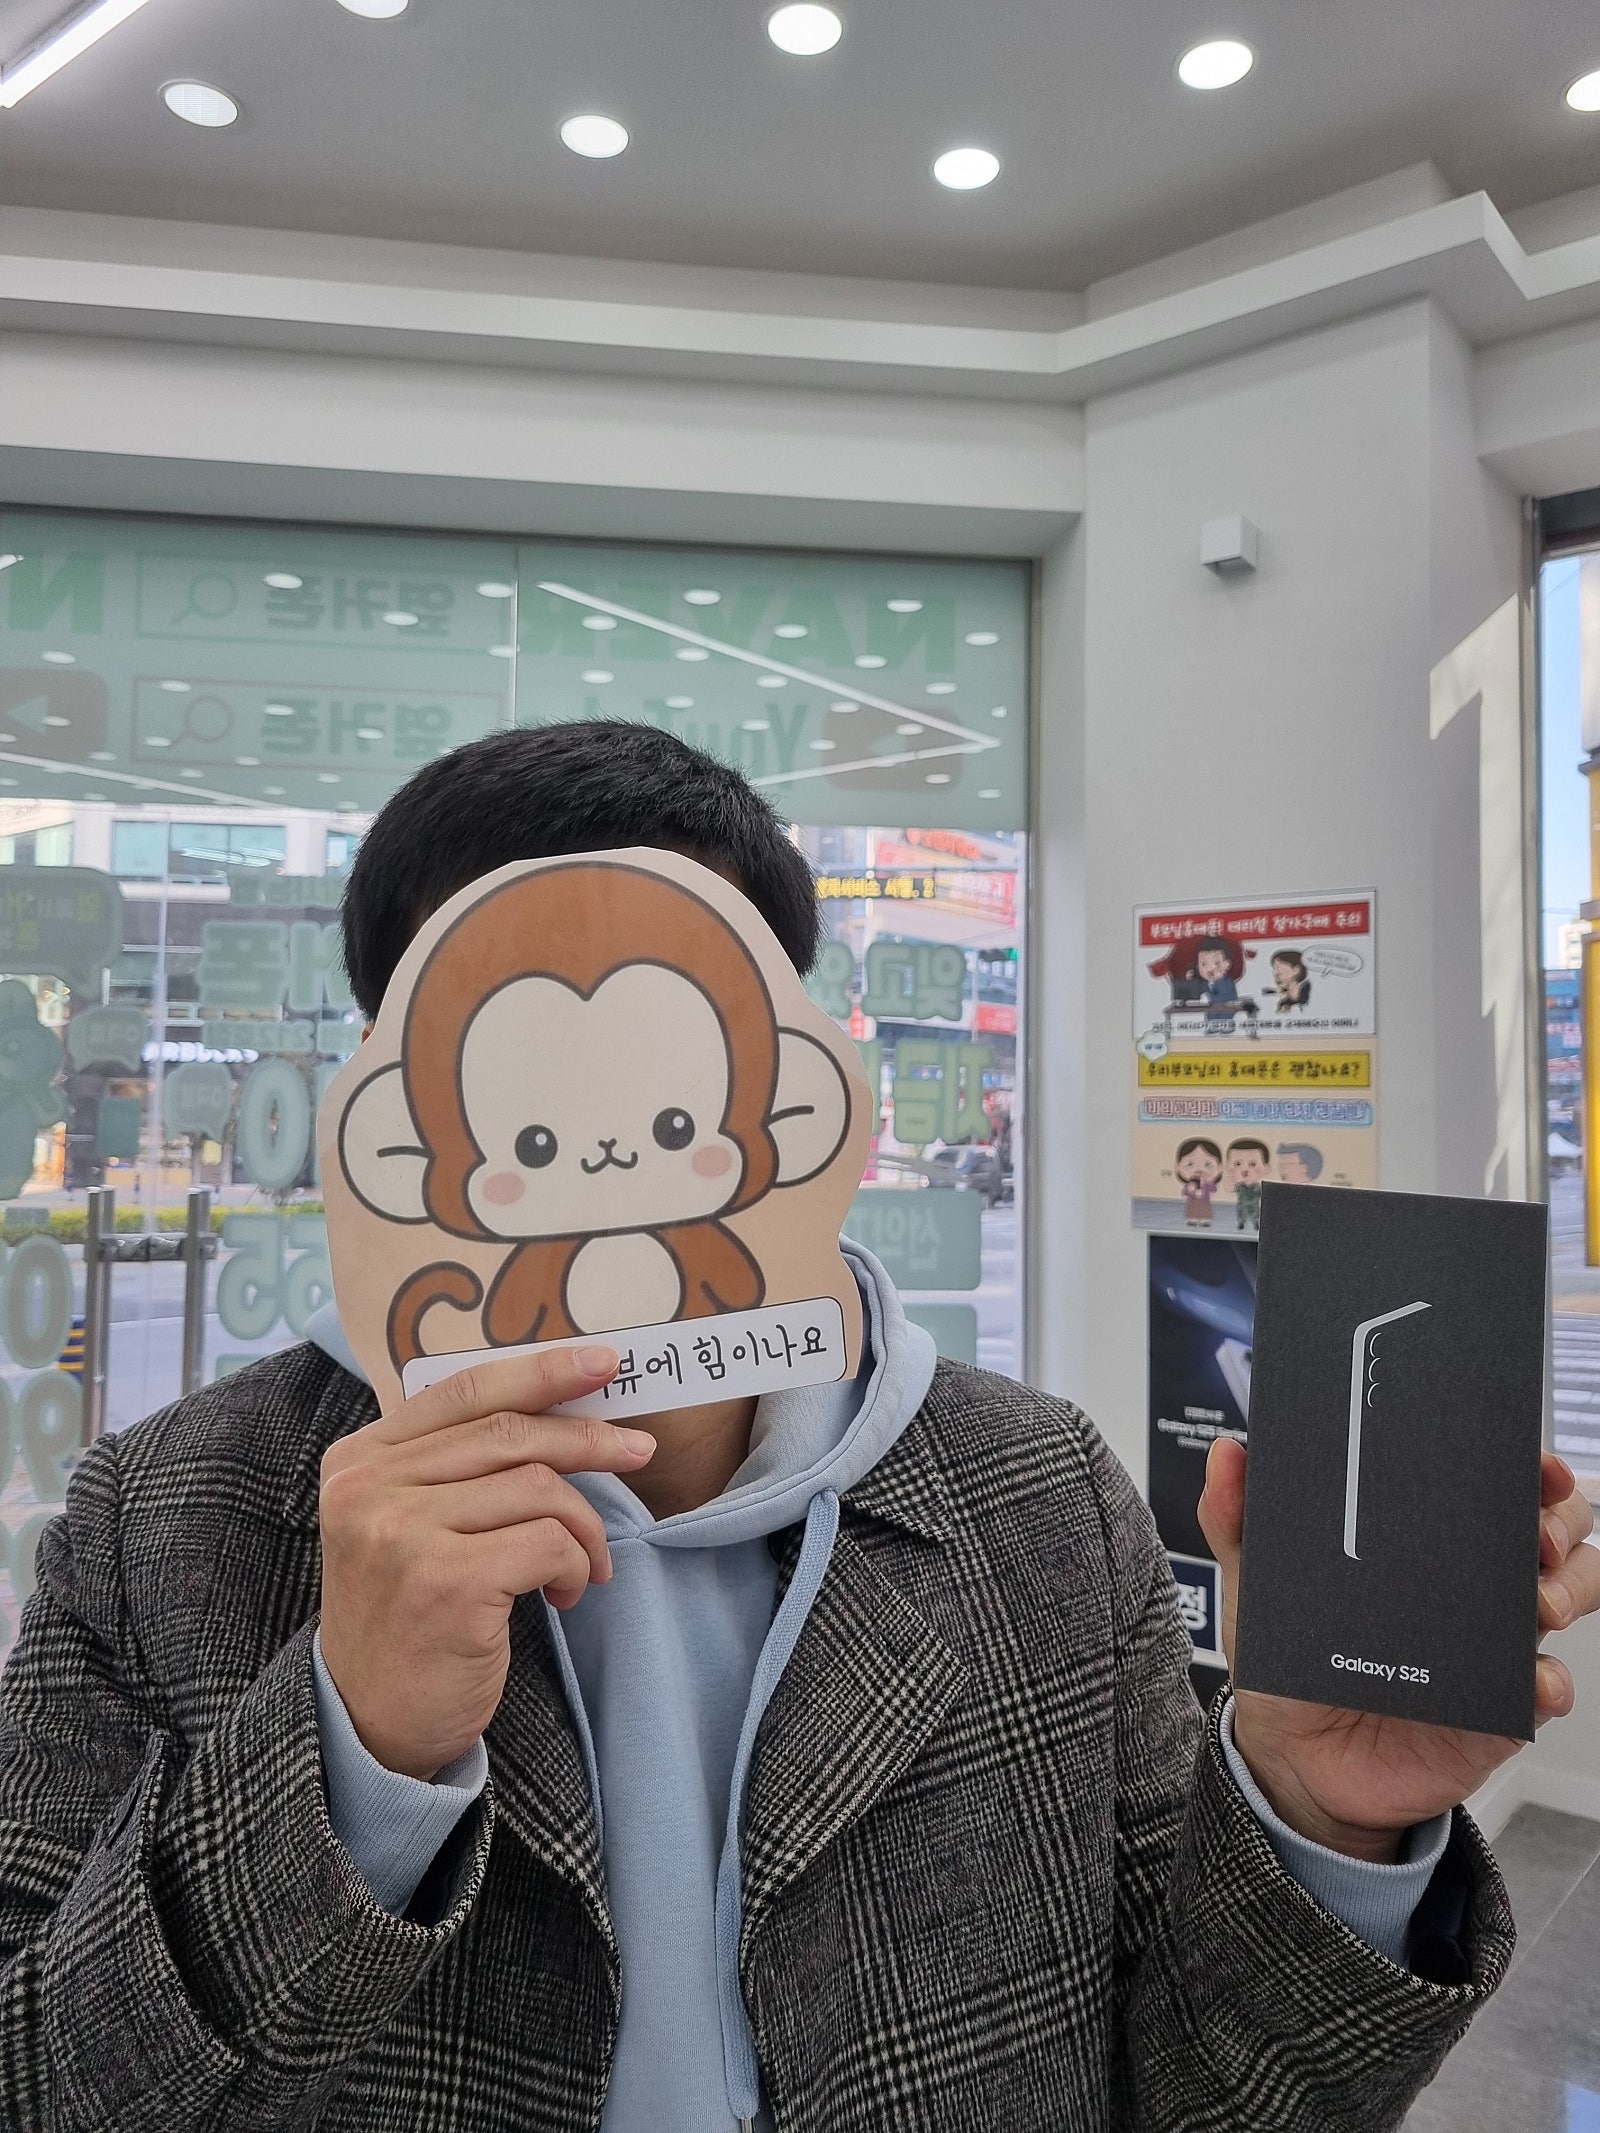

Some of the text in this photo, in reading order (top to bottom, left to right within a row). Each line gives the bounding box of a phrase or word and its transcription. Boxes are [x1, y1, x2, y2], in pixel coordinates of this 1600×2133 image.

[692, 1323, 828, 1381] 힘이나요
[1330, 1653, 1430, 1684] Galaxy S25
